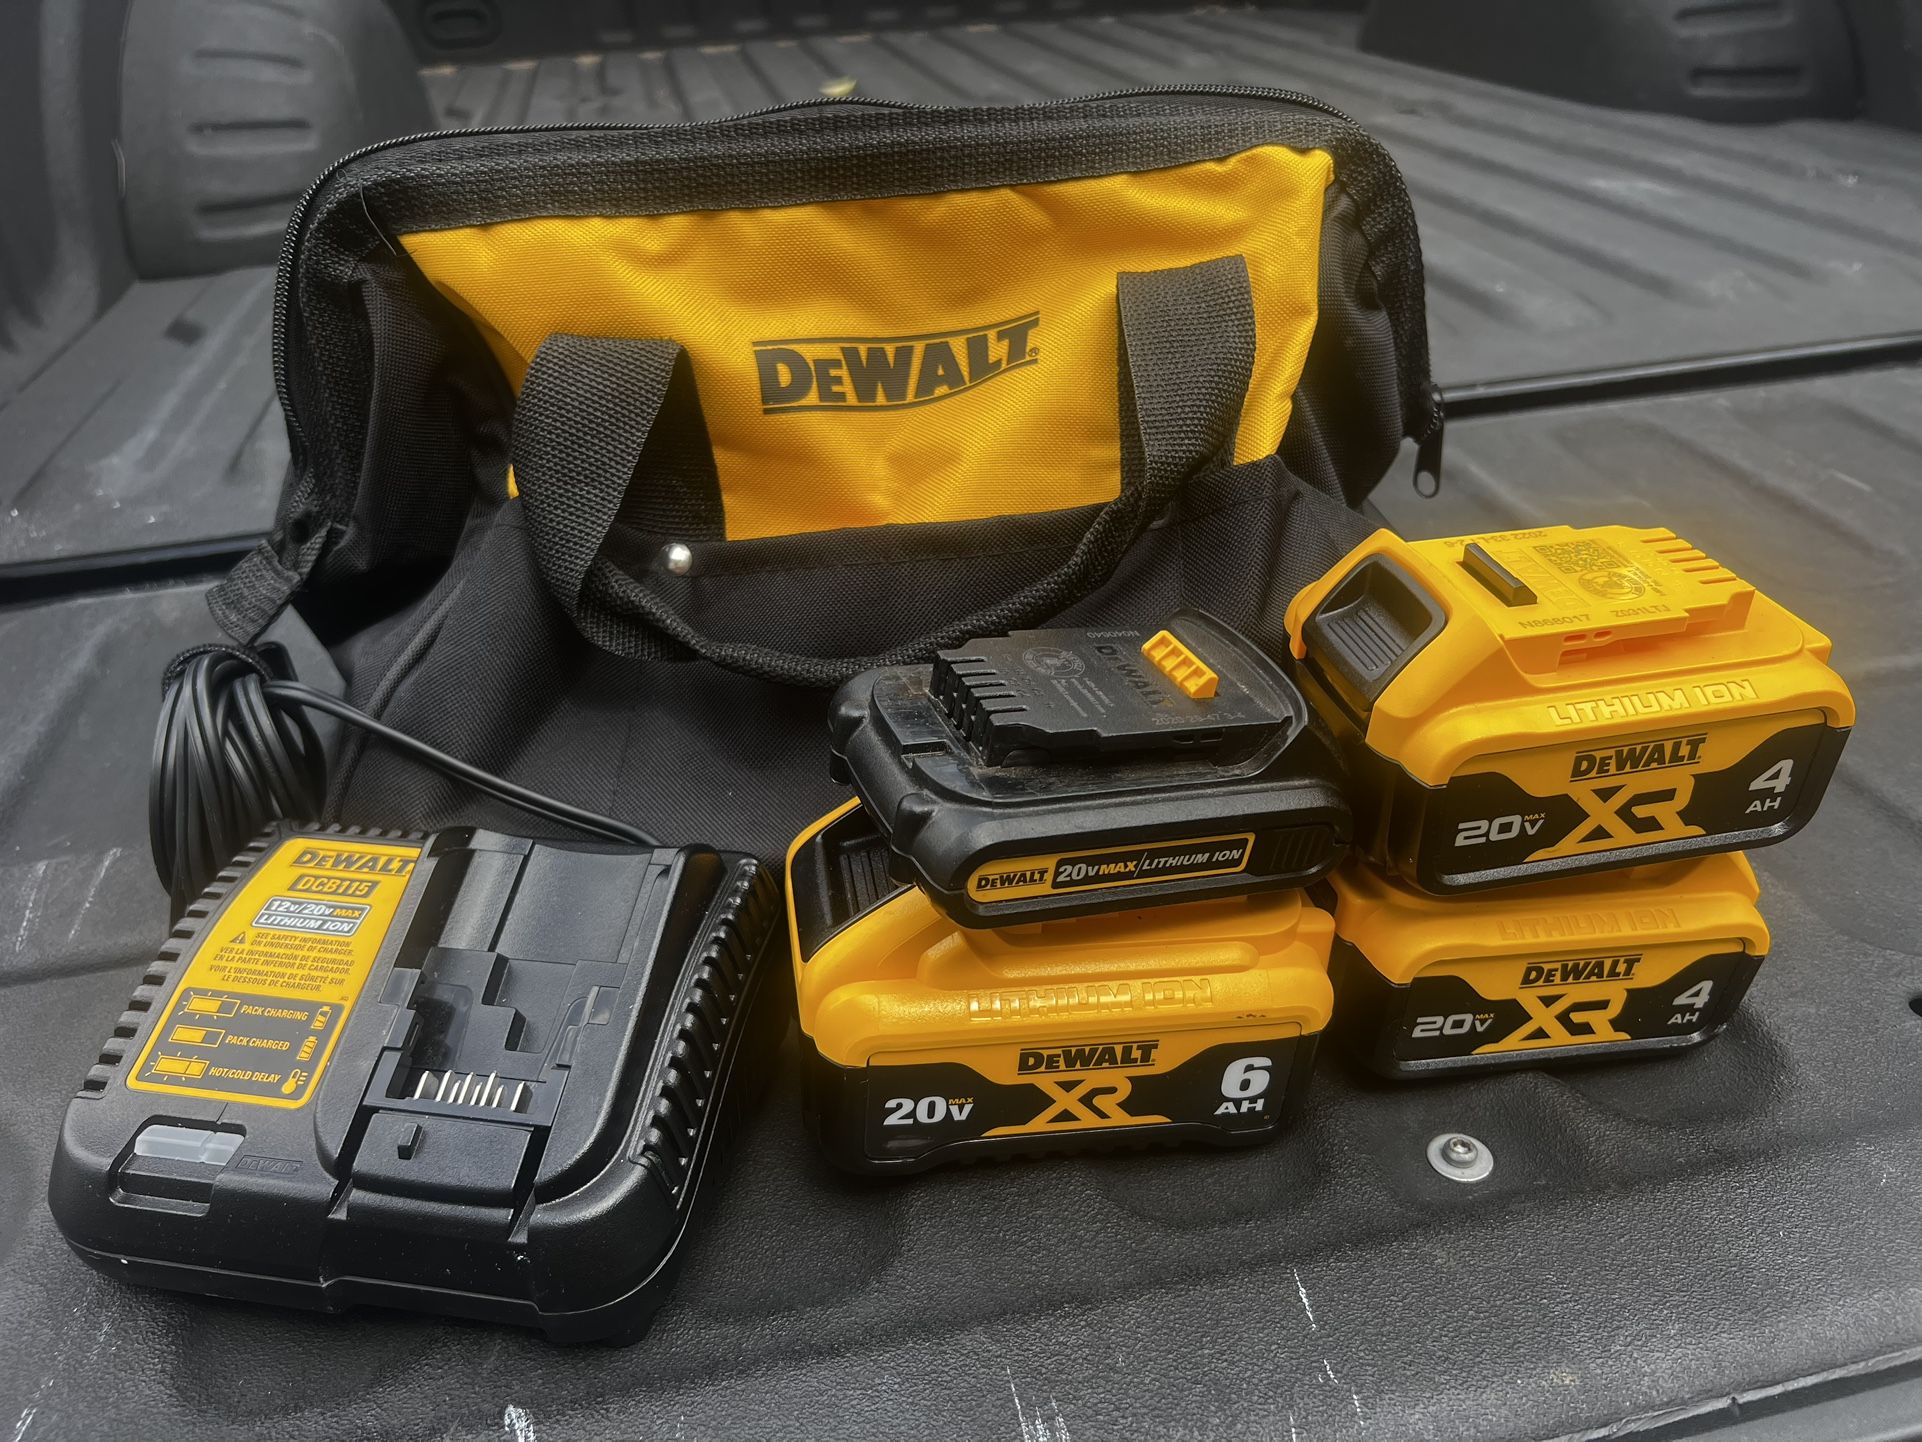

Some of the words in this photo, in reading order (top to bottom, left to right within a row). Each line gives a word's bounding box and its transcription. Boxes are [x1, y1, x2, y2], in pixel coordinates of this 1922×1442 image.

[1547, 686, 1691, 727] LITHIUM
[1692, 679, 1759, 706] ION
[1748, 759, 1795, 794] 4
[1745, 796, 1782, 814] AH
[1522, 811, 1547, 822] MAX
[1524, 774, 1707, 863] XR
[1212, 848, 1243, 863] ION
[296, 875, 372, 896] DCB115
[258, 914, 320, 929] LITHIUM
[322, 921, 354, 932] ION
[1497, 912, 1622, 941] LITHIUM
[1627, 906, 1681, 931] ION
[251, 939, 264, 947] ON
[264, 941, 307, 953] UNDERSIDE
[307, 945, 318, 953] OF
[255, 931, 271, 940] SEE
[271, 933, 298, 943] SAFETY
[299, 936, 353, 949] INFORMATION
[213, 953, 225, 961] EN
[225, 955, 236, 963] LA
[236, 956, 260, 967] PARTE
[260, 959, 296, 970] INFERIOR
[296, 963, 307, 971] DE
[220, 946, 234, 955] VER
[234, 948, 245, 956] LA
[245, 948, 299, 962] INFORMACIÓN
[299, 955, 310, 963] DE
[310, 956, 355, 968] SEGURIDAD
[209, 965, 227, 974] VOIR
[287, 971, 299, 980] DE
[330, 978, 346, 987] SUR
[222, 974, 232, 982] LE
[232, 975, 268, 987] DESSOUS
[268, 980, 279, 988] DE
[969, 983, 1133, 1021] LITHIUM
[1141, 978, 1213, 1009] ION
[1671, 979, 1714, 1009] 4
[240, 1004, 264, 1015] PACK
[264, 1007, 309, 1021] CHARGING
[1471, 988, 1632, 1055] XR
[1474, 1011, 1496, 1021] MAX
[1666, 1011, 1701, 1026] AH
[225, 1034, 249, 1046] PACK
[249, 1037, 290, 1051] CHARGED
[209, 1066, 252, 1081] HOT/COLD
[252, 1071, 281, 1083] DELAY
[1220, 1055, 1272, 1099] 6
[948, 1096, 975, 1106] MAX
[981, 1076, 1172, 1137] XR
[1213, 1098, 1265, 1115] AH
